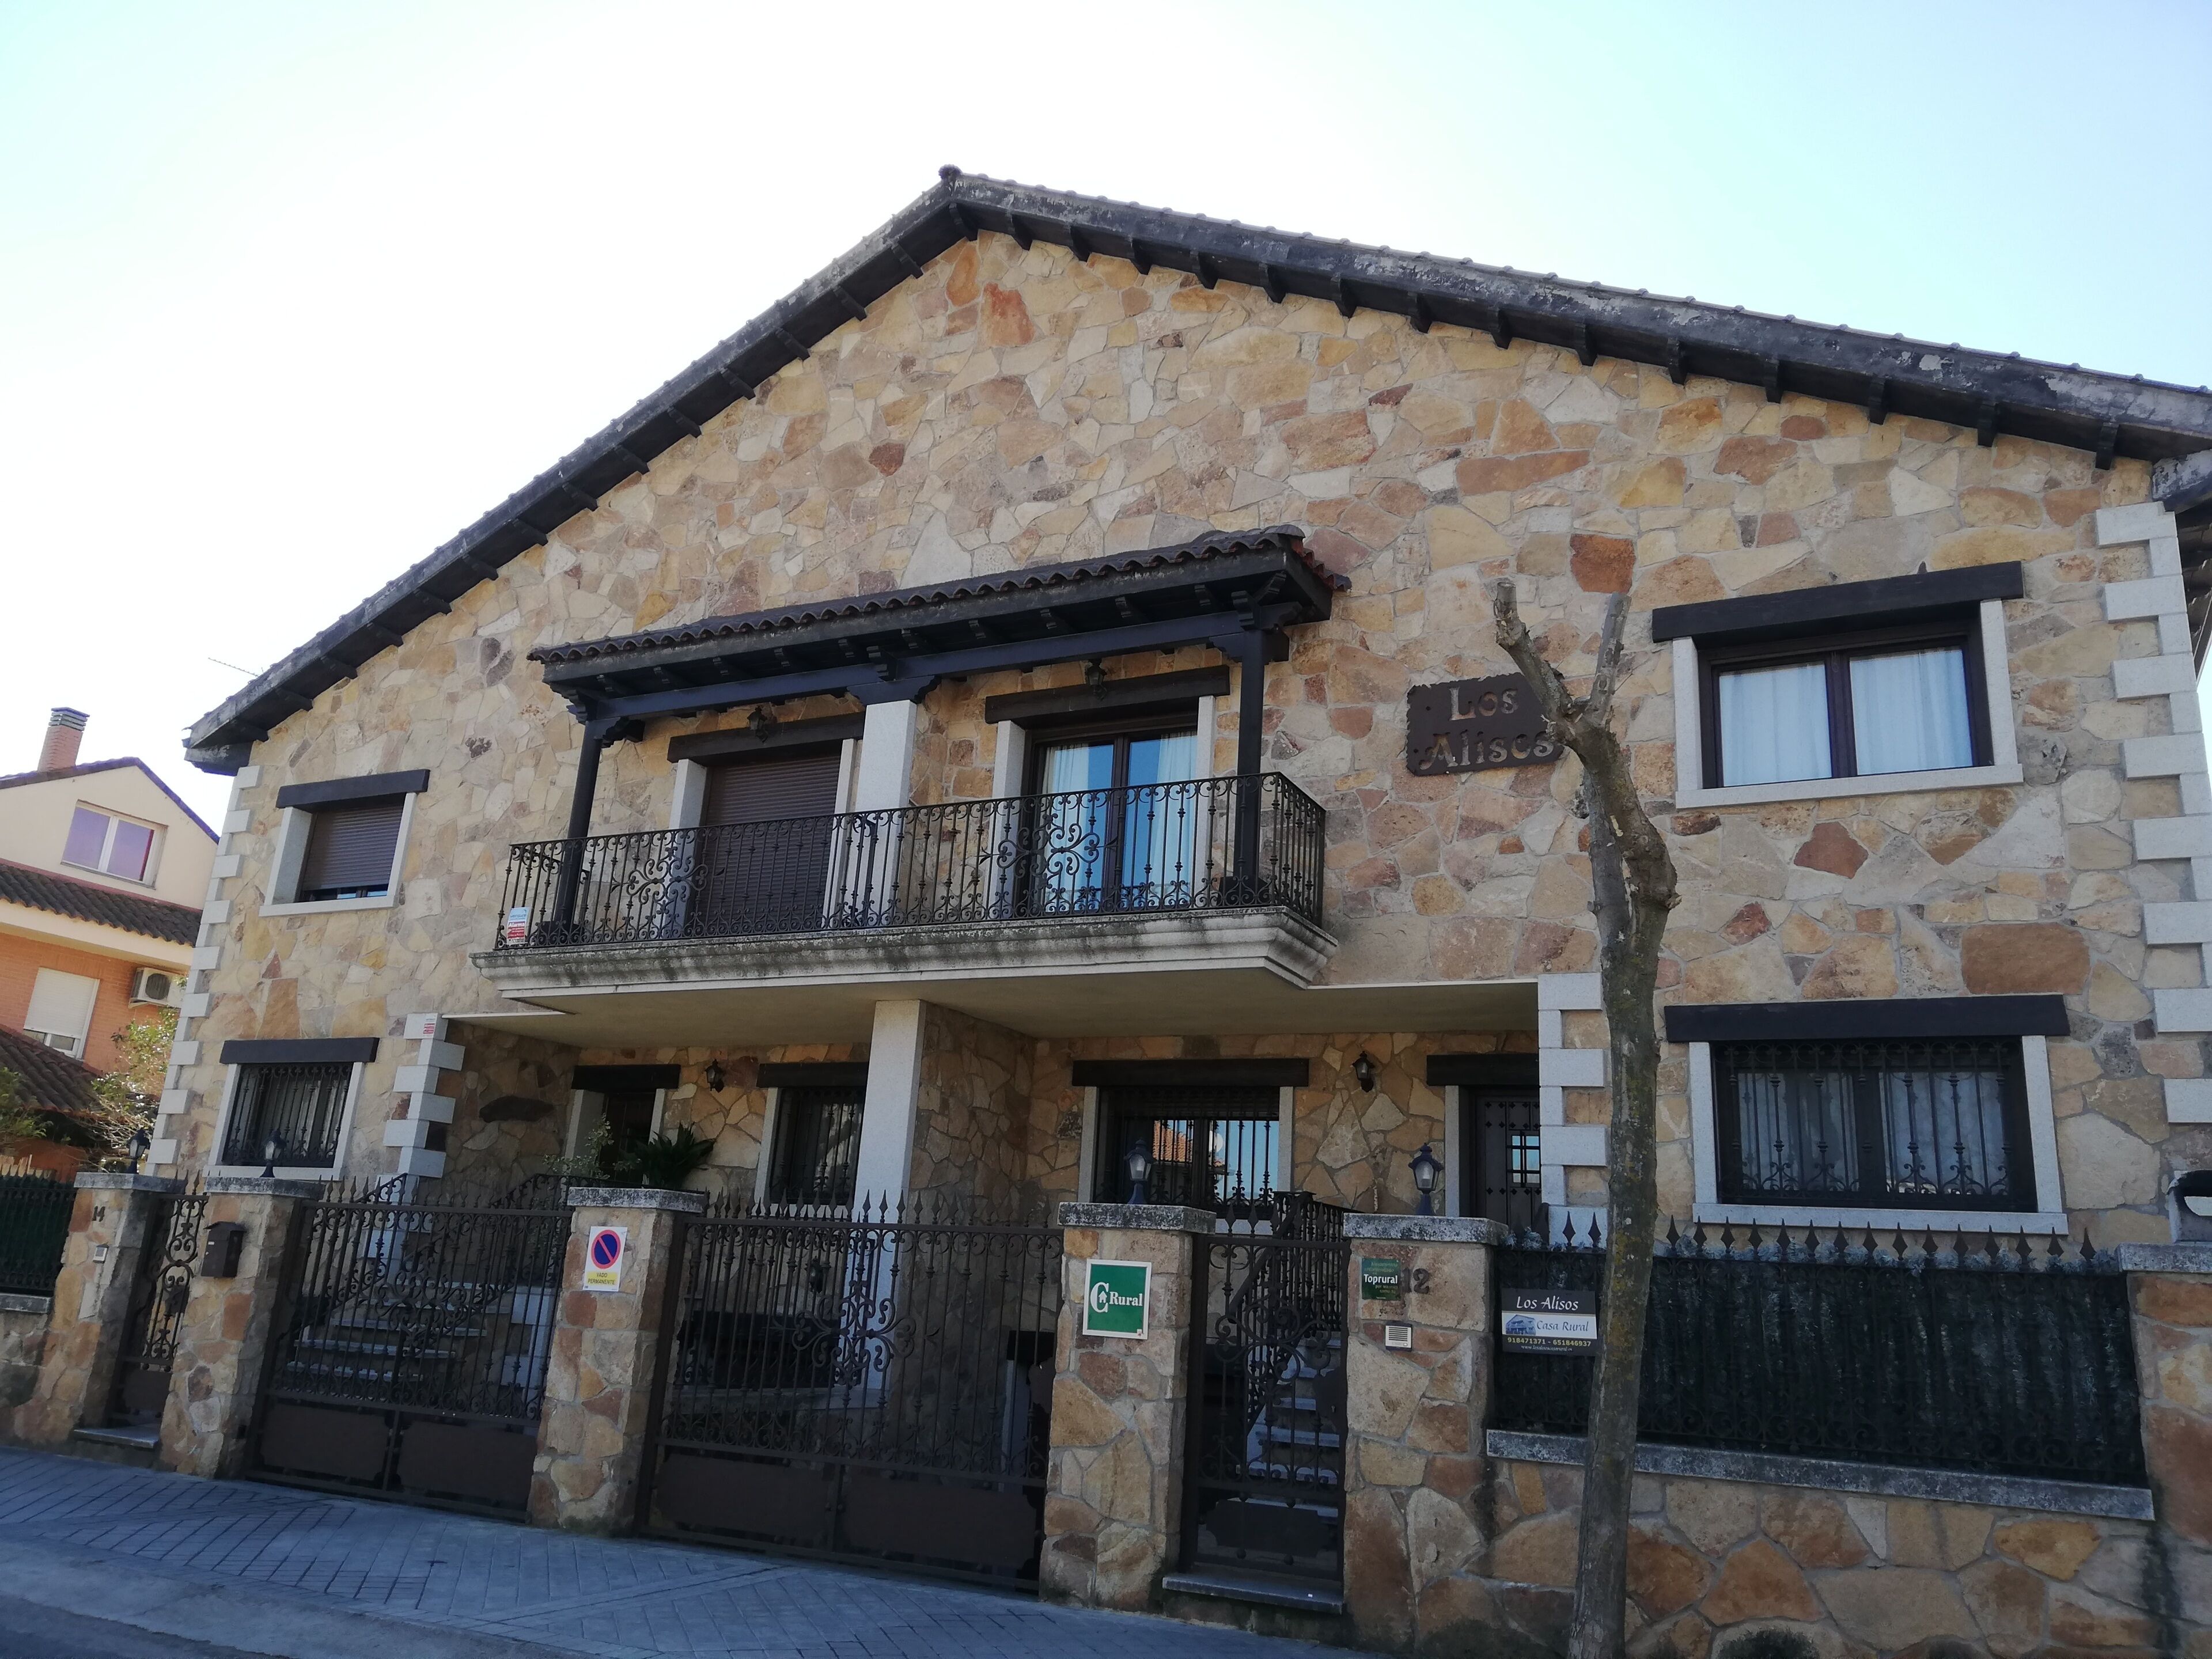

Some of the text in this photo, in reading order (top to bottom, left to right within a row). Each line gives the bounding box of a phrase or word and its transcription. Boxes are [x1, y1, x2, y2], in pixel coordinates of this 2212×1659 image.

[1449, 687, 1518, 721] Los
[92, 1206, 105, 1222] 14
[1363, 1274, 1398, 1285] Toprural
[1402, 1267, 1430, 1294] 12
[1109, 1291, 1143, 1306] Rural
[1516, 1296, 1579, 1311] Los Alisos
[1537, 1320, 1589, 1332] Casa Rural
[1508, 1336, 1546, 1345] 918471371
